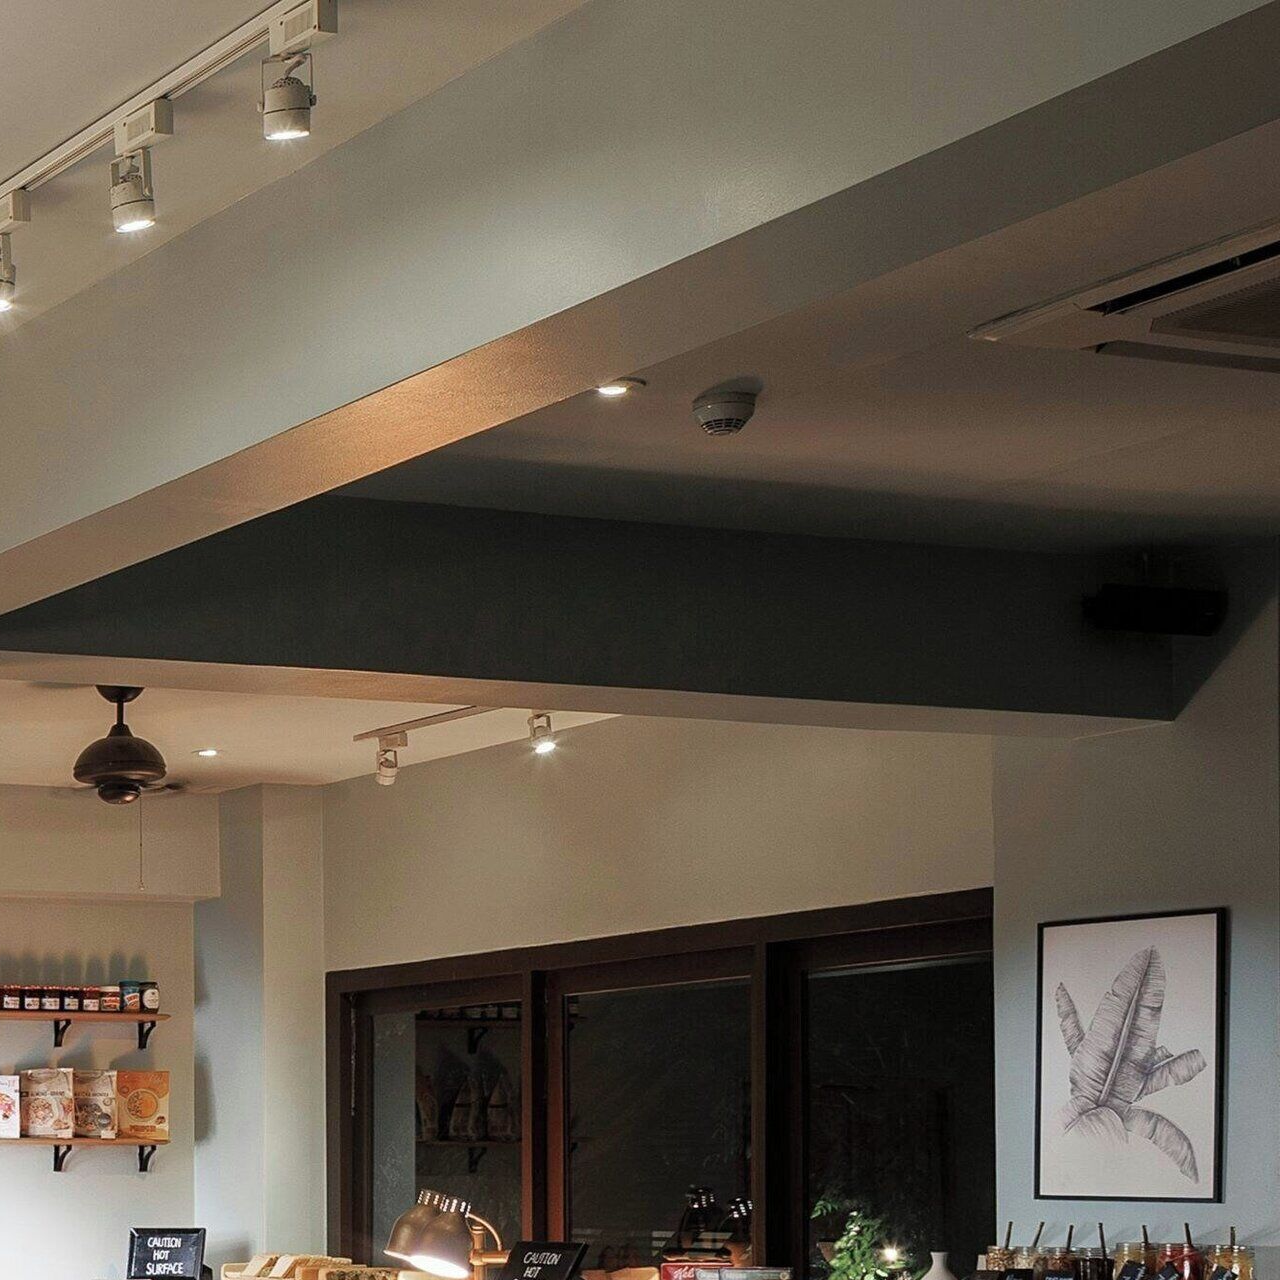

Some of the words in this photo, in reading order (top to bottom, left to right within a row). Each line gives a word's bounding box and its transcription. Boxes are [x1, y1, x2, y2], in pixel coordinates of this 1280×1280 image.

[147, 1237, 182, 1248] CAUTION
[153, 1250, 170, 1260] HOT
[523, 1252, 561, 1265] CAUTION
[146, 1262, 184, 1275] SURFACE
[523, 1266, 542, 1278] HOT
